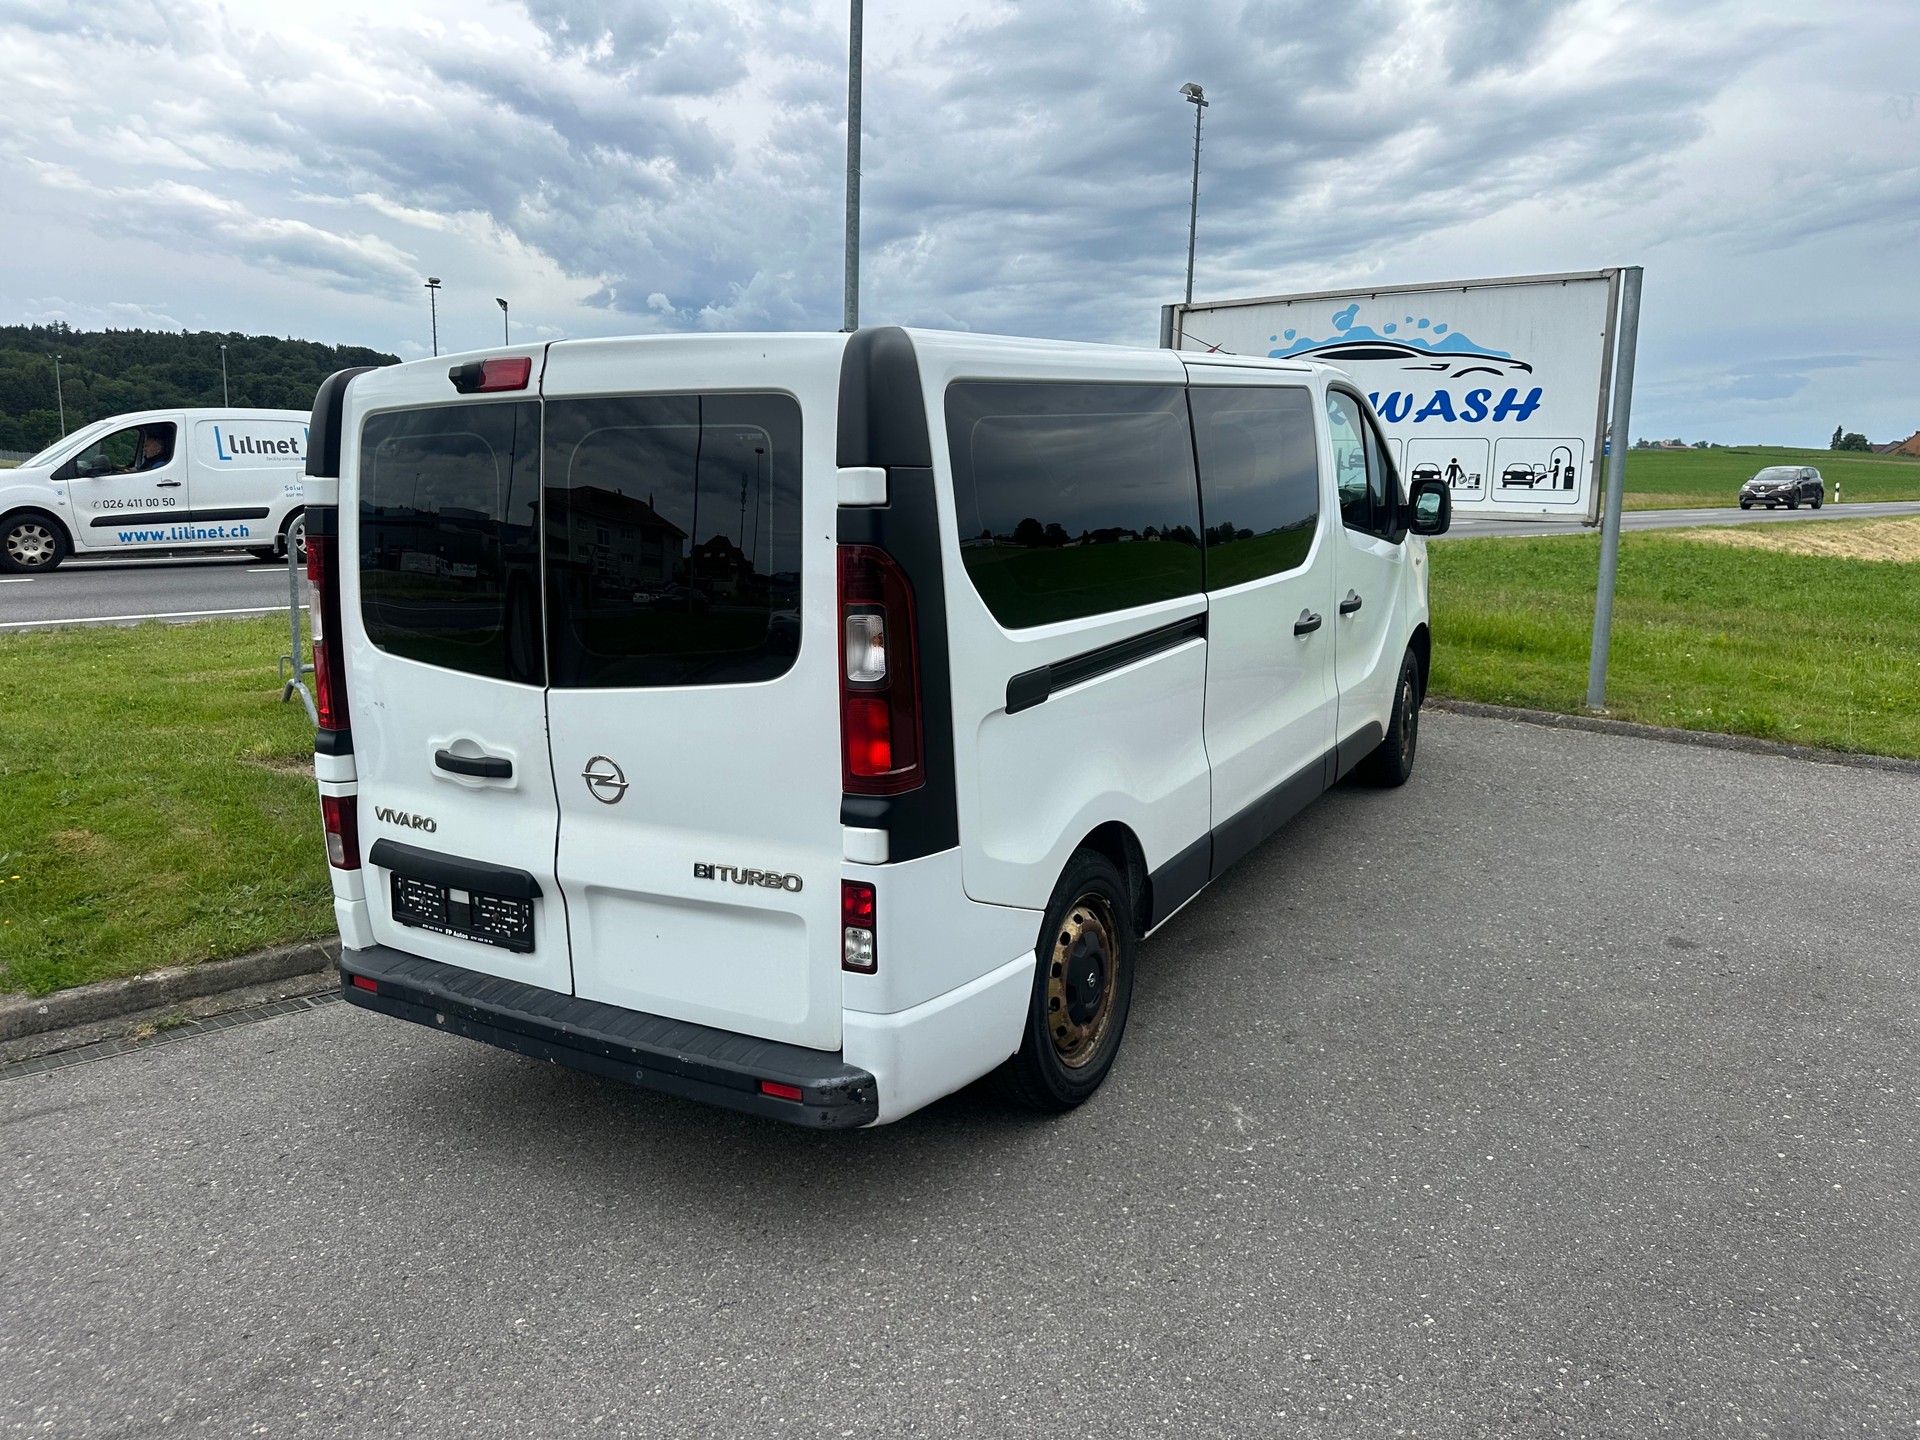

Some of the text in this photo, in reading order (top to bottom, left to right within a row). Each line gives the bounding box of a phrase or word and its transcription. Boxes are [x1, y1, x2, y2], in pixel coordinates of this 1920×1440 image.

[229, 435, 299, 454] lilinet
[102, 497, 176, 509] 026 411 00 50
[118, 524, 249, 542] www.lilinet.ch
[374, 805, 437, 833] VIVARO
[453, 931, 468, 939] Autos
